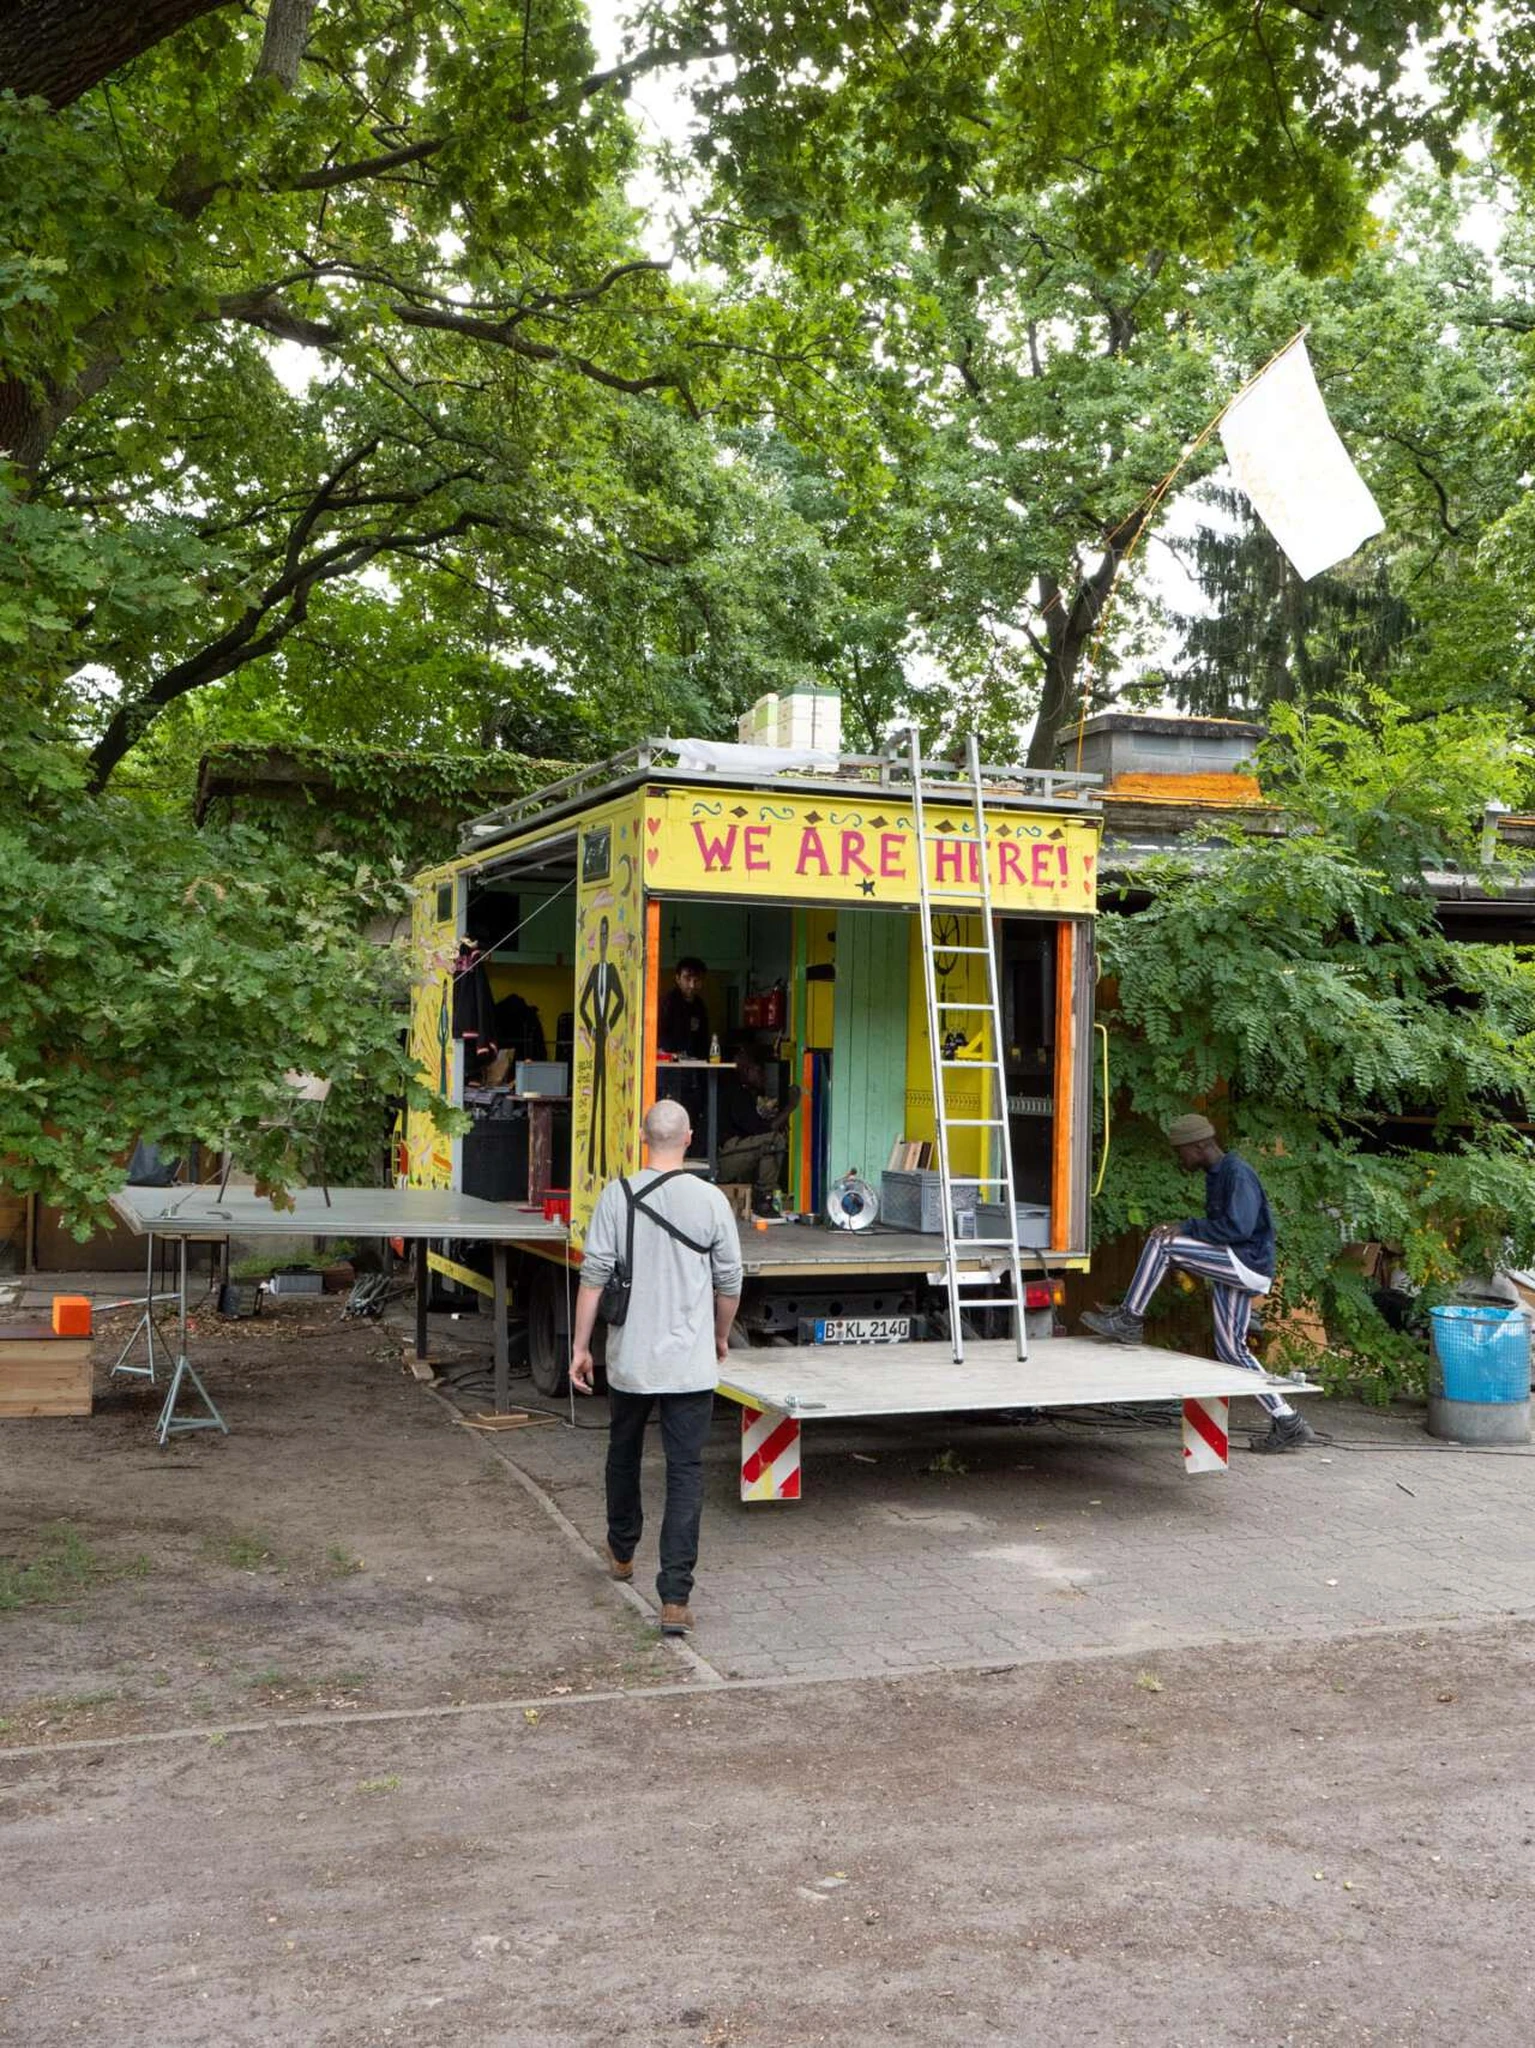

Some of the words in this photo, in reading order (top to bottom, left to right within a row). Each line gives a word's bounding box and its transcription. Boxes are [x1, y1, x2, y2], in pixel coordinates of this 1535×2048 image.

[690, 821, 771, 871] WE
[795, 826, 907, 880] ARE
[825, 1322, 835, 1339] B
[846, 1321, 865, 1338] KL
[870, 1320, 908, 1337] 2140
